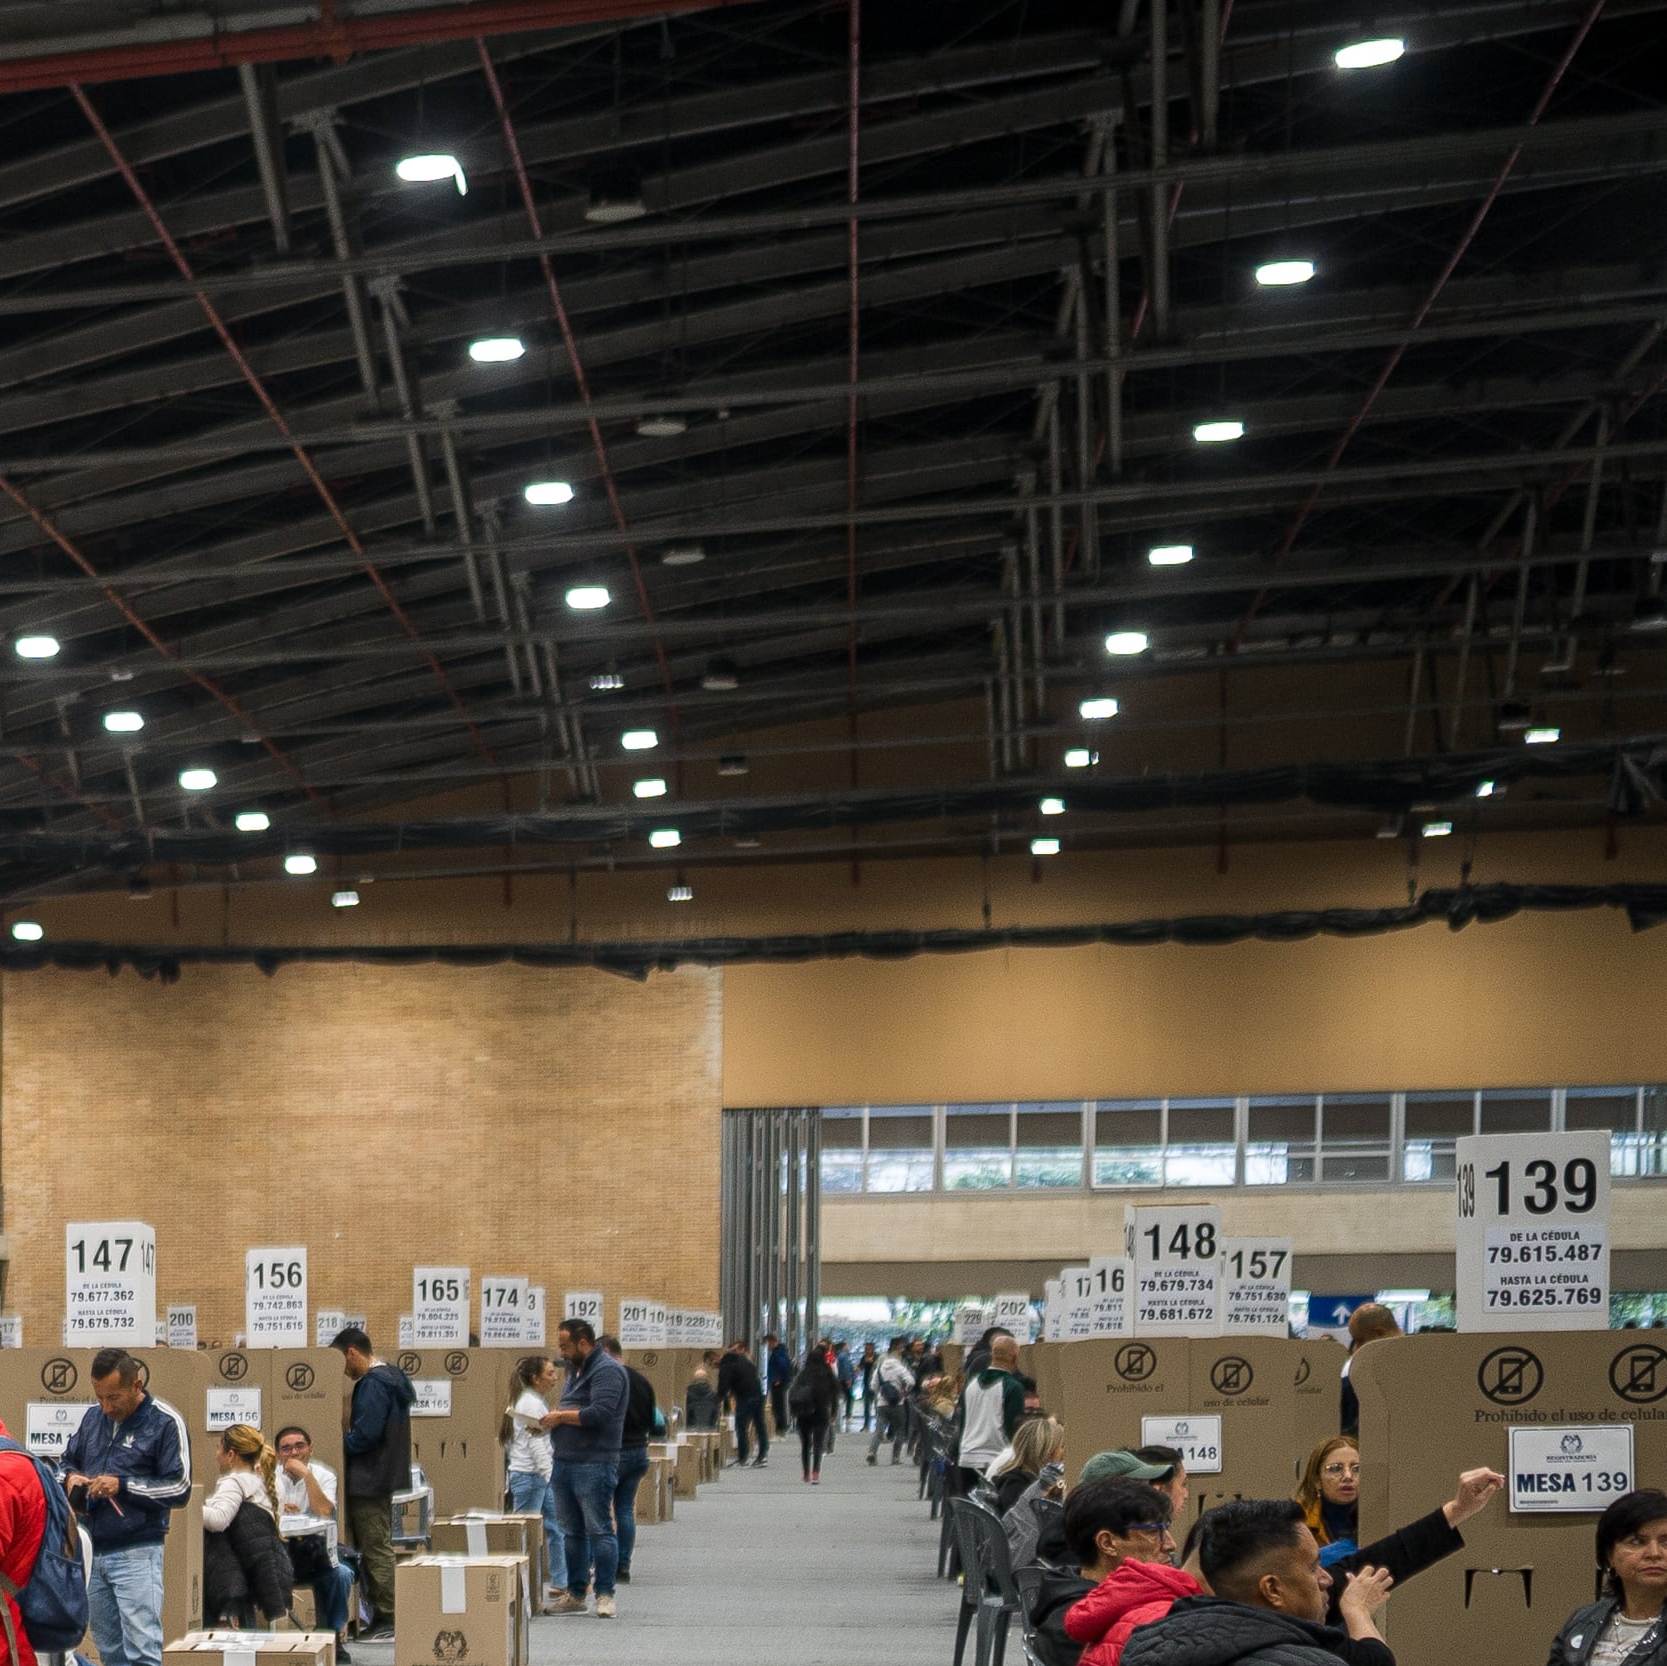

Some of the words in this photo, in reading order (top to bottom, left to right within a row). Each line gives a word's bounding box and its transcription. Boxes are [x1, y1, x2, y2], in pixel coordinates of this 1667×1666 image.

[1458, 1163, 1475, 1217] 139
[1486, 1158, 1597, 1215] 139
[1144, 1222, 1217, 1260] 148
[1510, 1233, 1522, 1241] DE
[1526, 1233, 1537, 1241] LA
[1542, 1230, 1580, 1240] CÉDULA
[71, 1238, 133, 1273] 147
[1488, 1245, 1602, 1263] 79.615.487
[1231, 1251, 1287, 1279] 157
[254, 1262, 302, 1290] 156
[1096, 1269, 1124, 1293] 16
[1501, 1276, 1531, 1285] HASTA
[1535, 1276, 1546, 1284] LA
[1550, 1275, 1588, 1284] CÉDULA
[418, 1279, 459, 1301] 165
[1076, 1278, 1091, 1297] 17
[1141, 1280, 1213, 1291] 79.679.734
[71, 1290, 135, 1302] 79.677.362
[483, 1288, 518, 1307] 174
[1488, 1288, 1601, 1307] 79.625.769
[570, 1301, 596, 1316] 192
[624, 1308, 647, 1321] 201
[1001, 1302, 1026, 1315] 202
[1140, 1308, 1213, 1320] 79.681.672
[71, 1318, 135, 1328] 79.679.732
[169, 1312, 193, 1326] 200
[650, 1311, 664, 1323] 10
[1107, 1384, 1153, 1393] Prohibido
[1155, 1384, 1163, 1392] el
[432, 1400, 449, 1408] 165
[211, 1412, 236, 1422] MESA
[238, 1412, 258, 1421] 156
[1475, 1410, 1546, 1422] Prohibido
[1552, 1409, 1564, 1422] el
[1569, 1411, 1594, 1421] uso
[1599, 1408, 1616, 1420] de
[1621, 1407, 1667, 1421] celula
[31, 1433, 62, 1444] MESA
[1188, 1447, 1217, 1460] 148
[1517, 1473, 1576, 1492] MESA
[1582, 1472, 1627, 1491] 139
